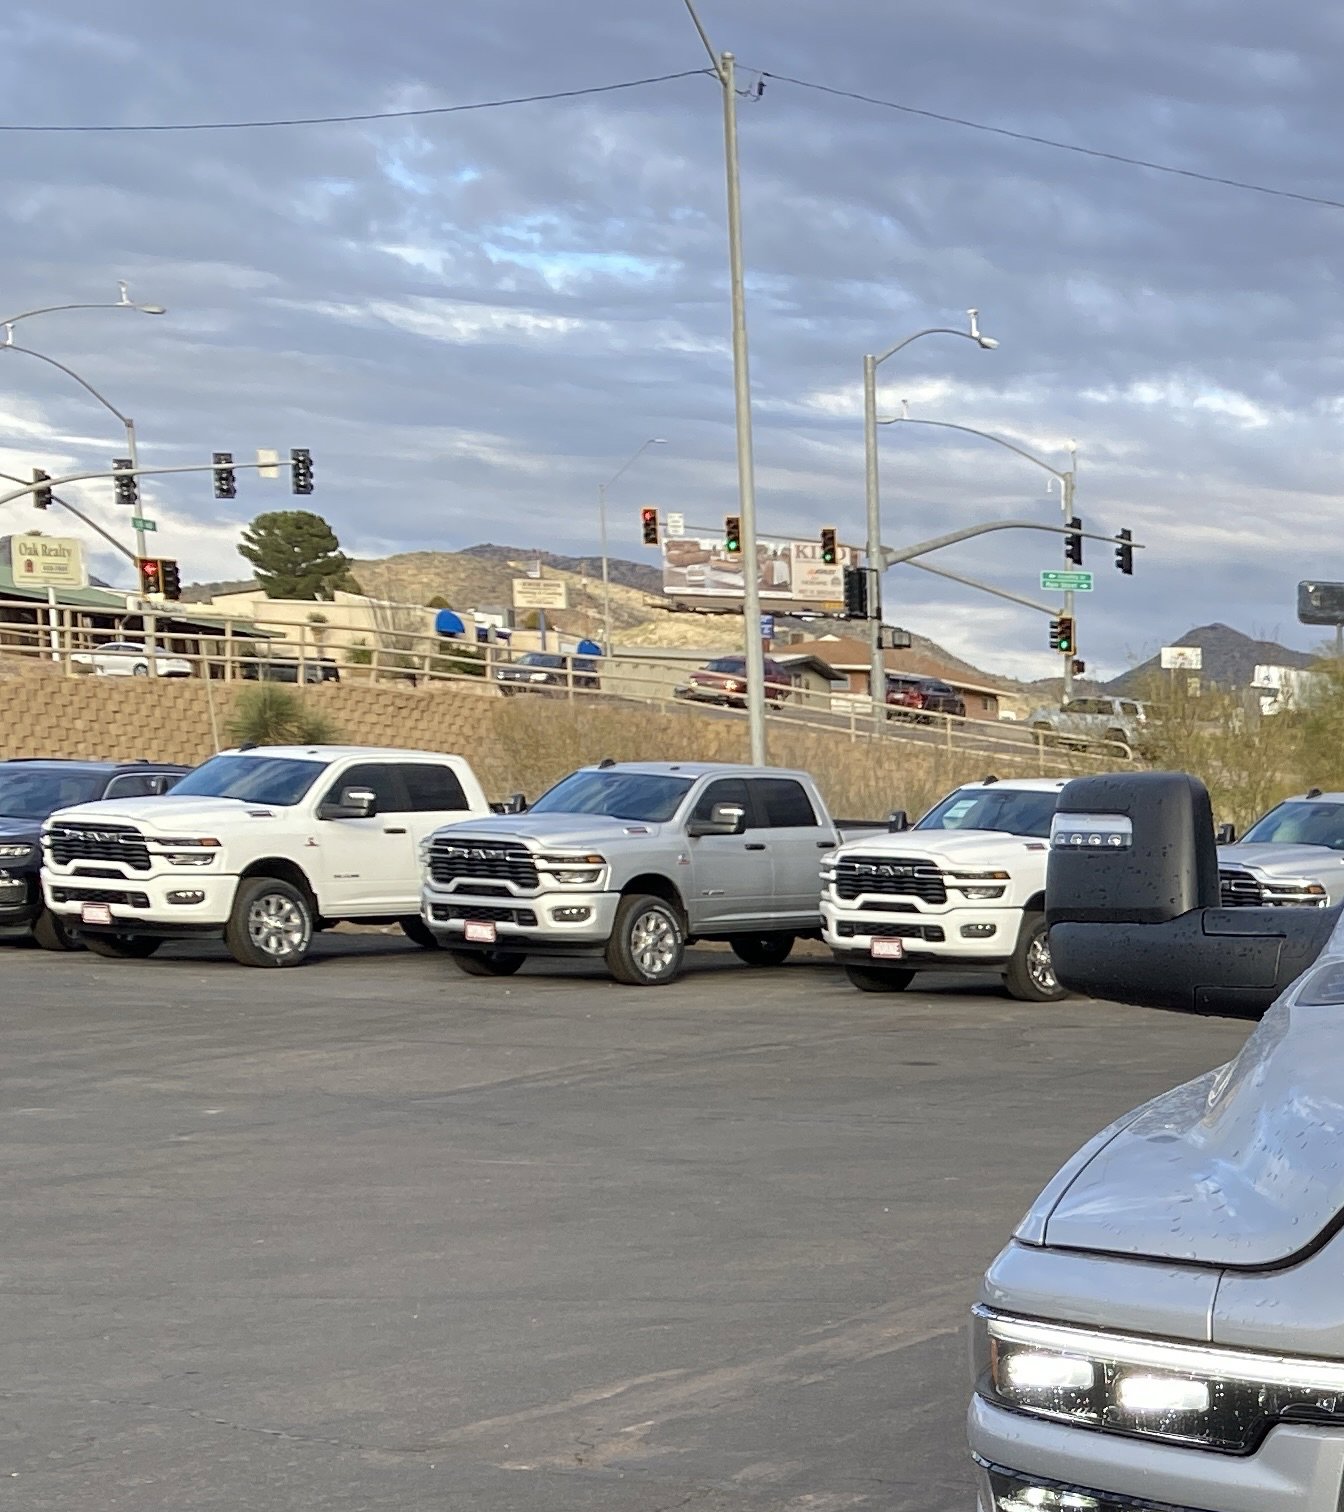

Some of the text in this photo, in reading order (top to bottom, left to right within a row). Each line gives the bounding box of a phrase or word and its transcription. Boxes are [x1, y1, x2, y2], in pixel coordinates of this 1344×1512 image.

[19, 542, 72, 560] Oak Realty
[857, 864, 913, 877] RAM
